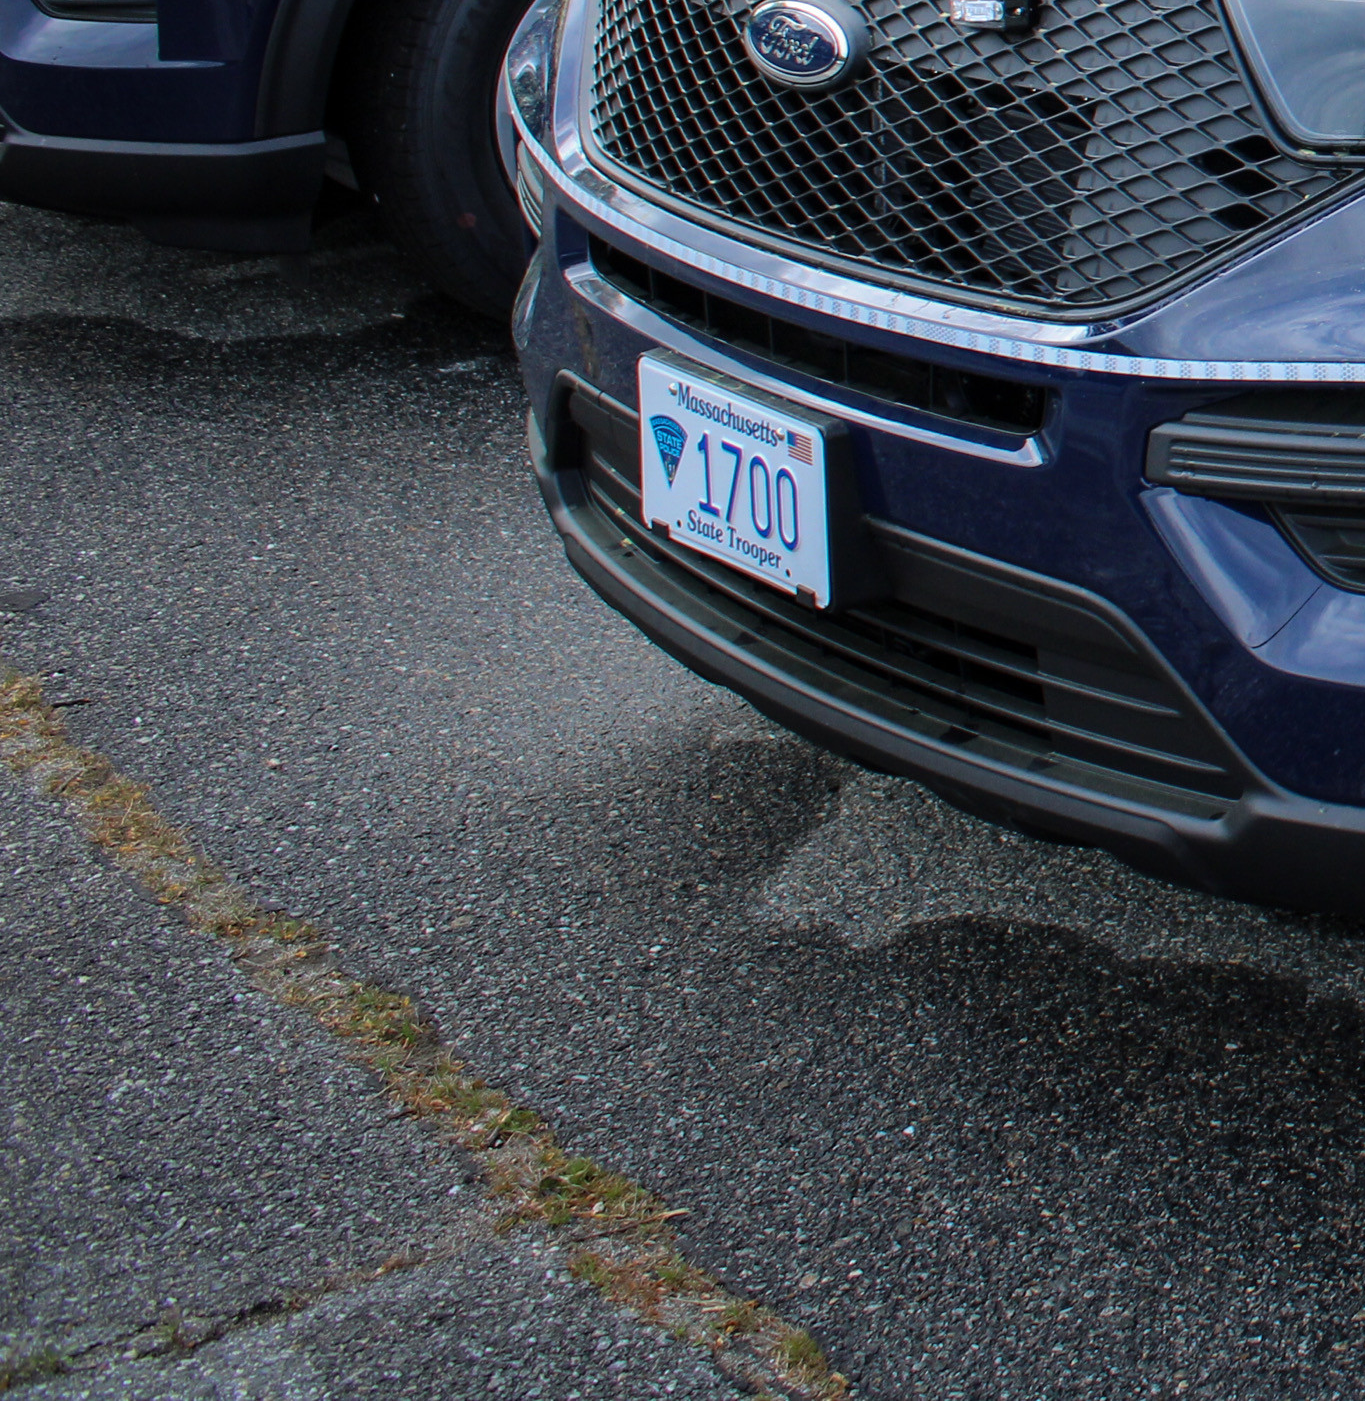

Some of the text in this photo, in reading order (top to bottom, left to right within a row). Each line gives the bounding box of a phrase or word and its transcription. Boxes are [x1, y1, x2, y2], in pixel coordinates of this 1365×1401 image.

[759, 14, 820, 67] Ford
[656, 430, 683, 450] STATE
[677, 382, 778, 447] Massachusetts
[697, 430, 800, 551] 1700
[687, 509, 782, 569] State Trooper
